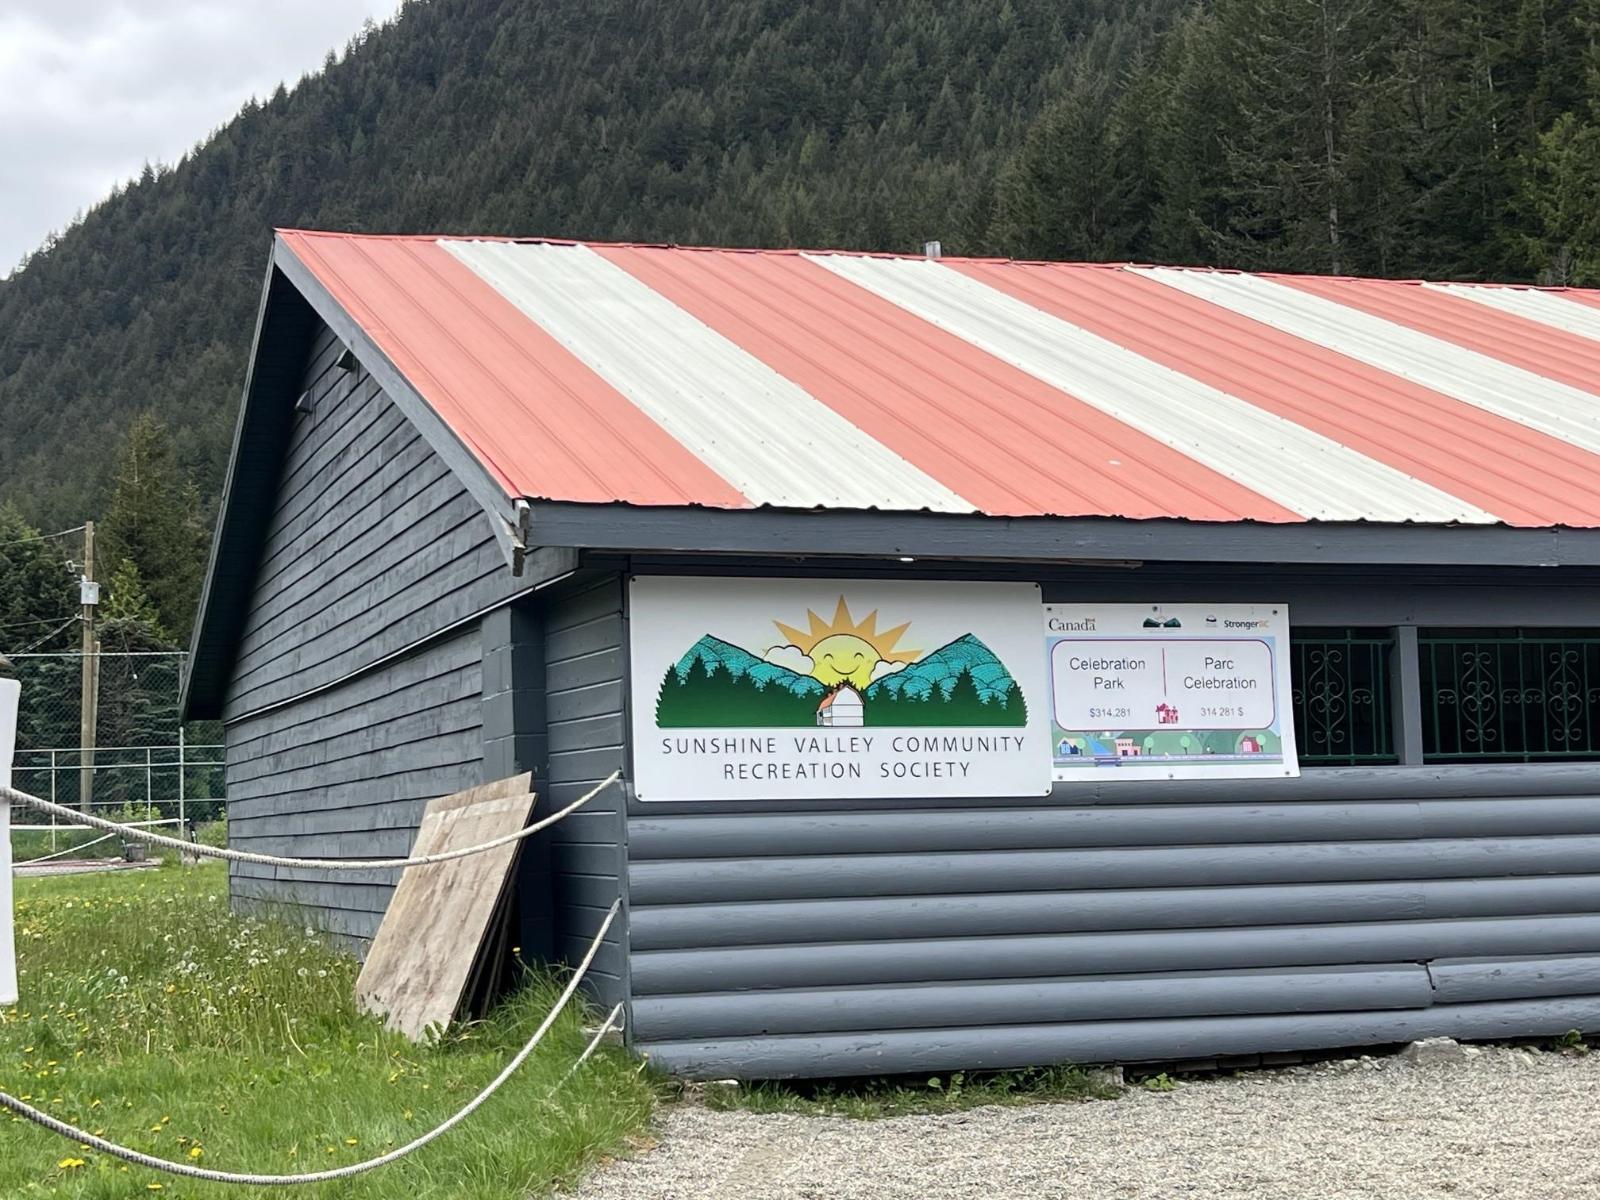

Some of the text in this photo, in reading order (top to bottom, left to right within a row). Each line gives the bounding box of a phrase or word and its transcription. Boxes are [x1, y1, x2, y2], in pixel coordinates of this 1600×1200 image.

[1048, 617, 1096, 632] Canada
[1069, 656, 1146, 671] Celebration
[1204, 656, 1235, 670] Parc
[1093, 676, 1125, 690] Park
[1183, 675, 1257, 690] Celebration
[1200, 706, 1244, 717] 314 281 $
[662, 736, 1025, 754] SUNSHINE VALLEY COMMUNITY
[723, 761, 971, 779] RECREATION SOCIETY
